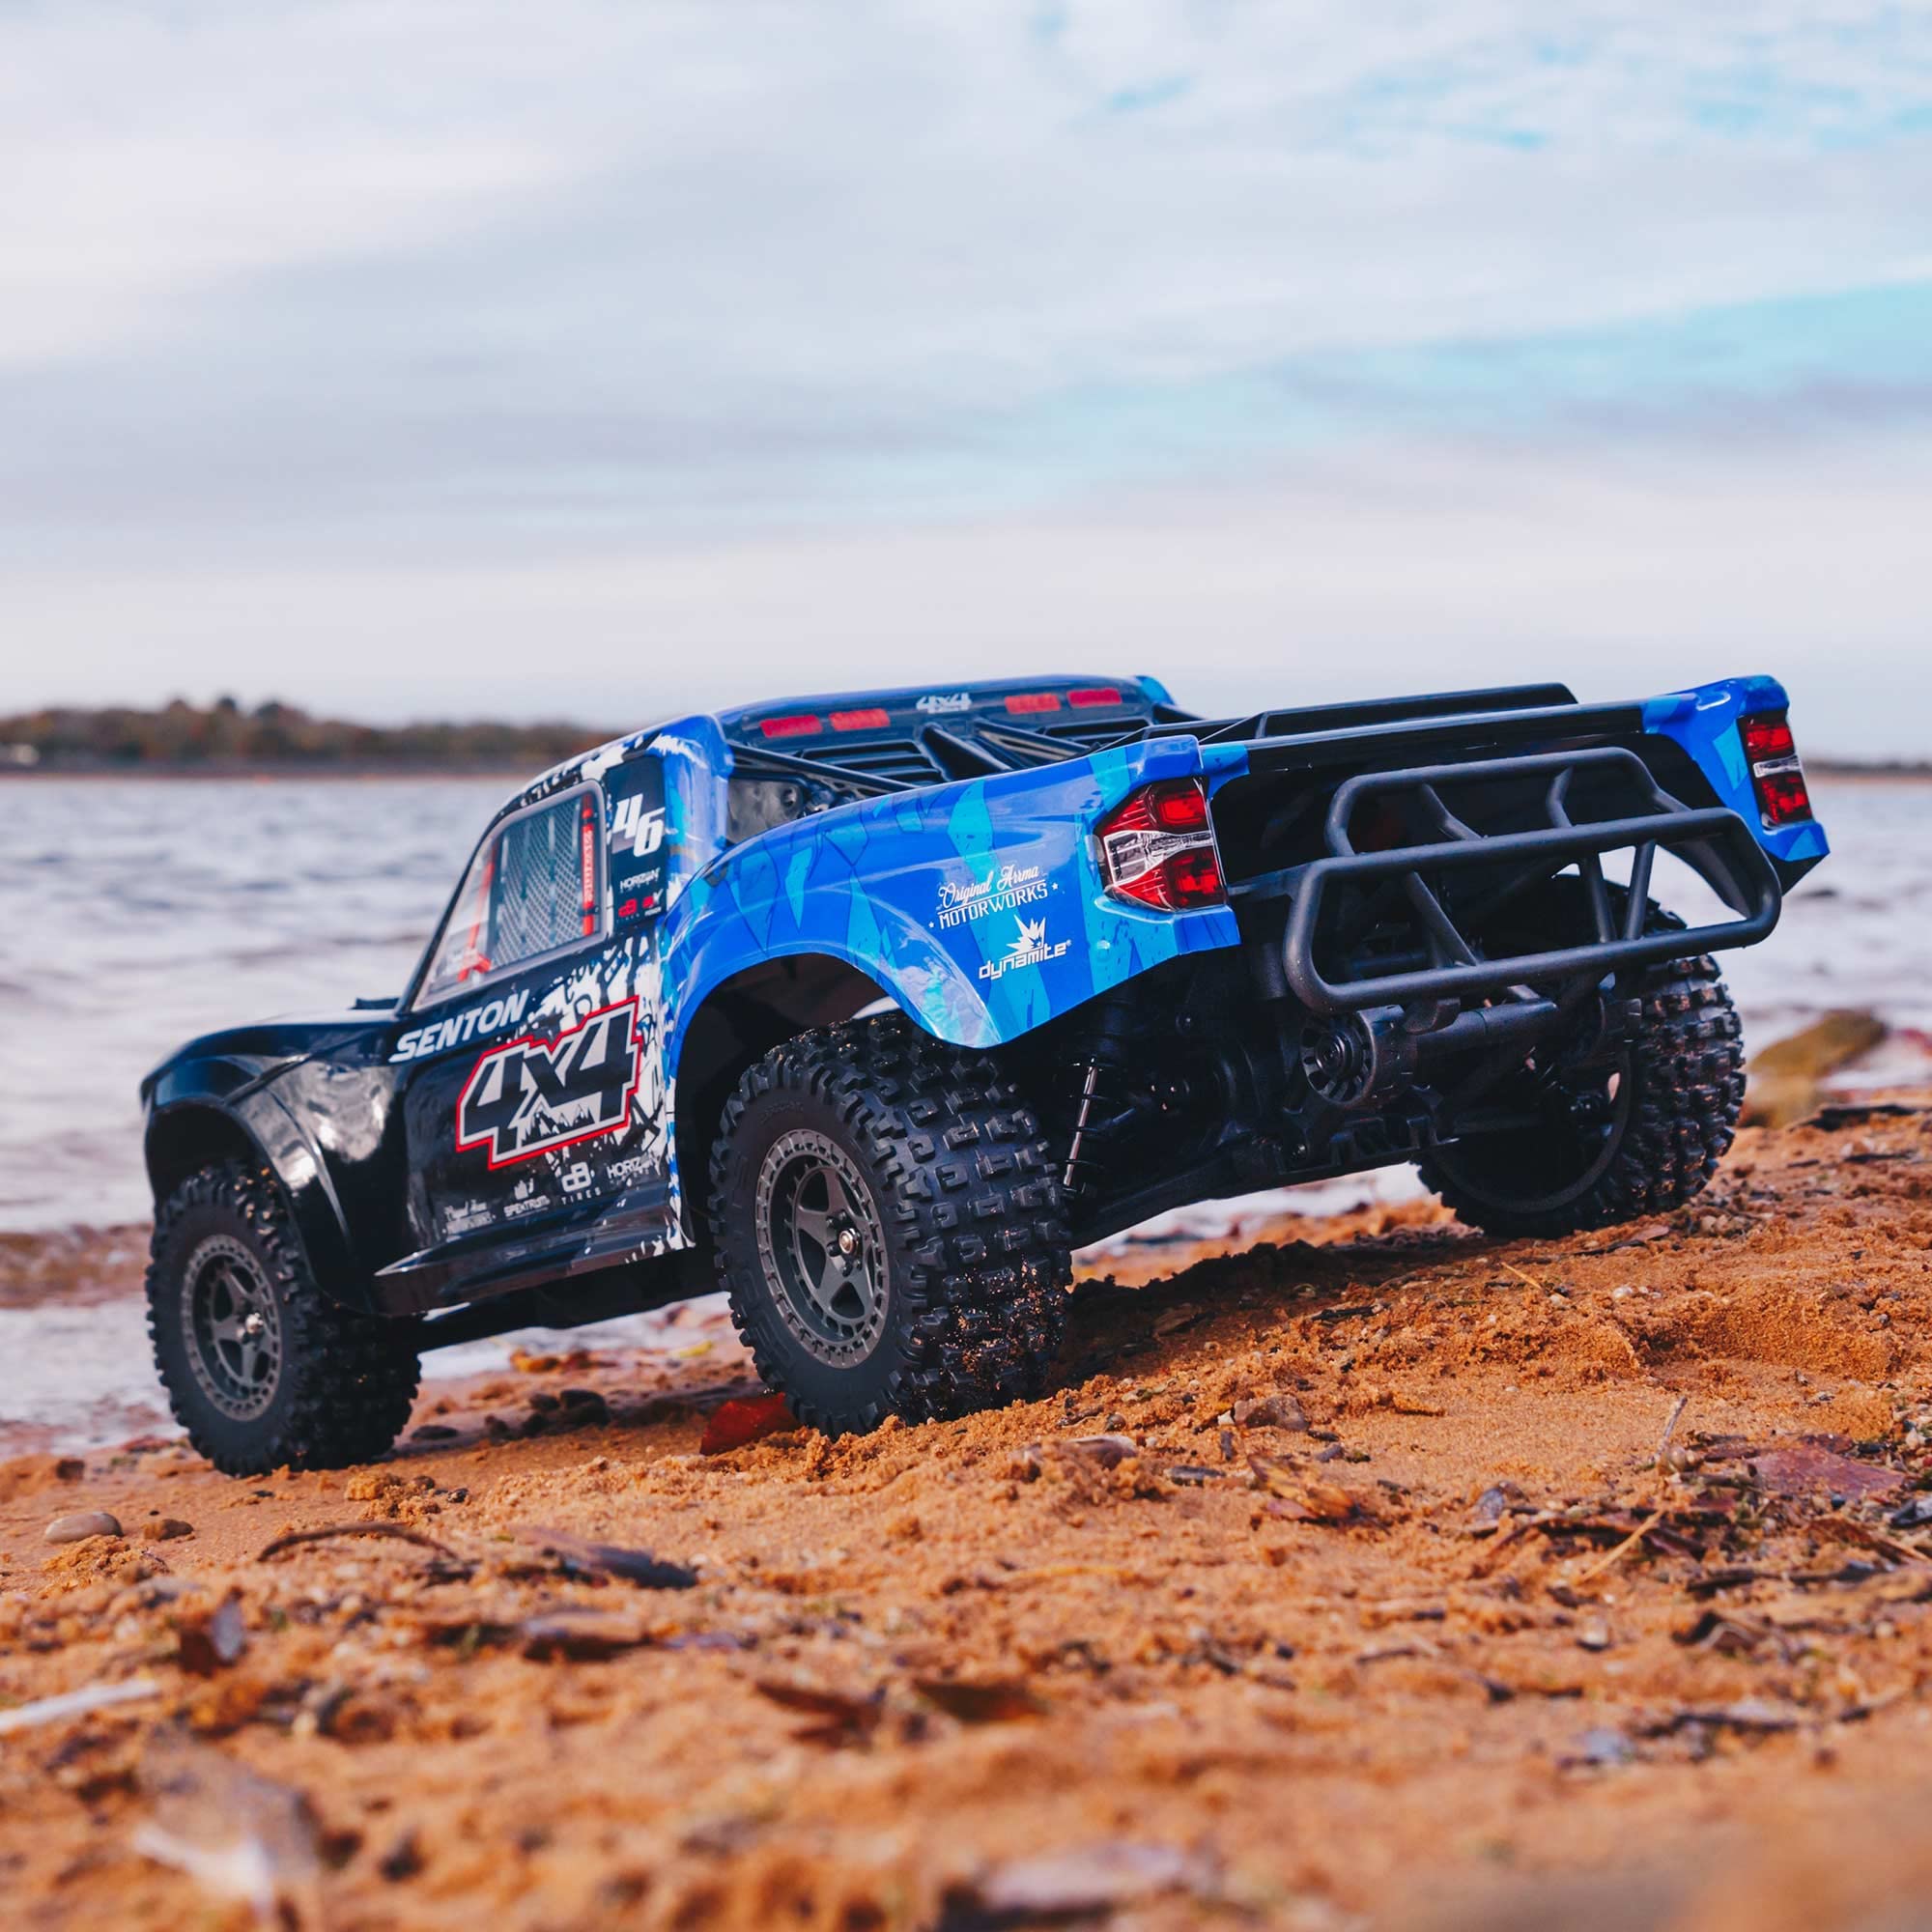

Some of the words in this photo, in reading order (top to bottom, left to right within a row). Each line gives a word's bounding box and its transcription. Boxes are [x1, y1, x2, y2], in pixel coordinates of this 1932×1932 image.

[612, 793, 667, 858] 46
[938, 870, 994, 908] Original
[997, 865, 1040, 890] Arrma
[939, 882, 1049, 930] MOTORWORKS
[979, 942, 1068, 980] dynamite
[388, 988, 530, 1064] SENTON
